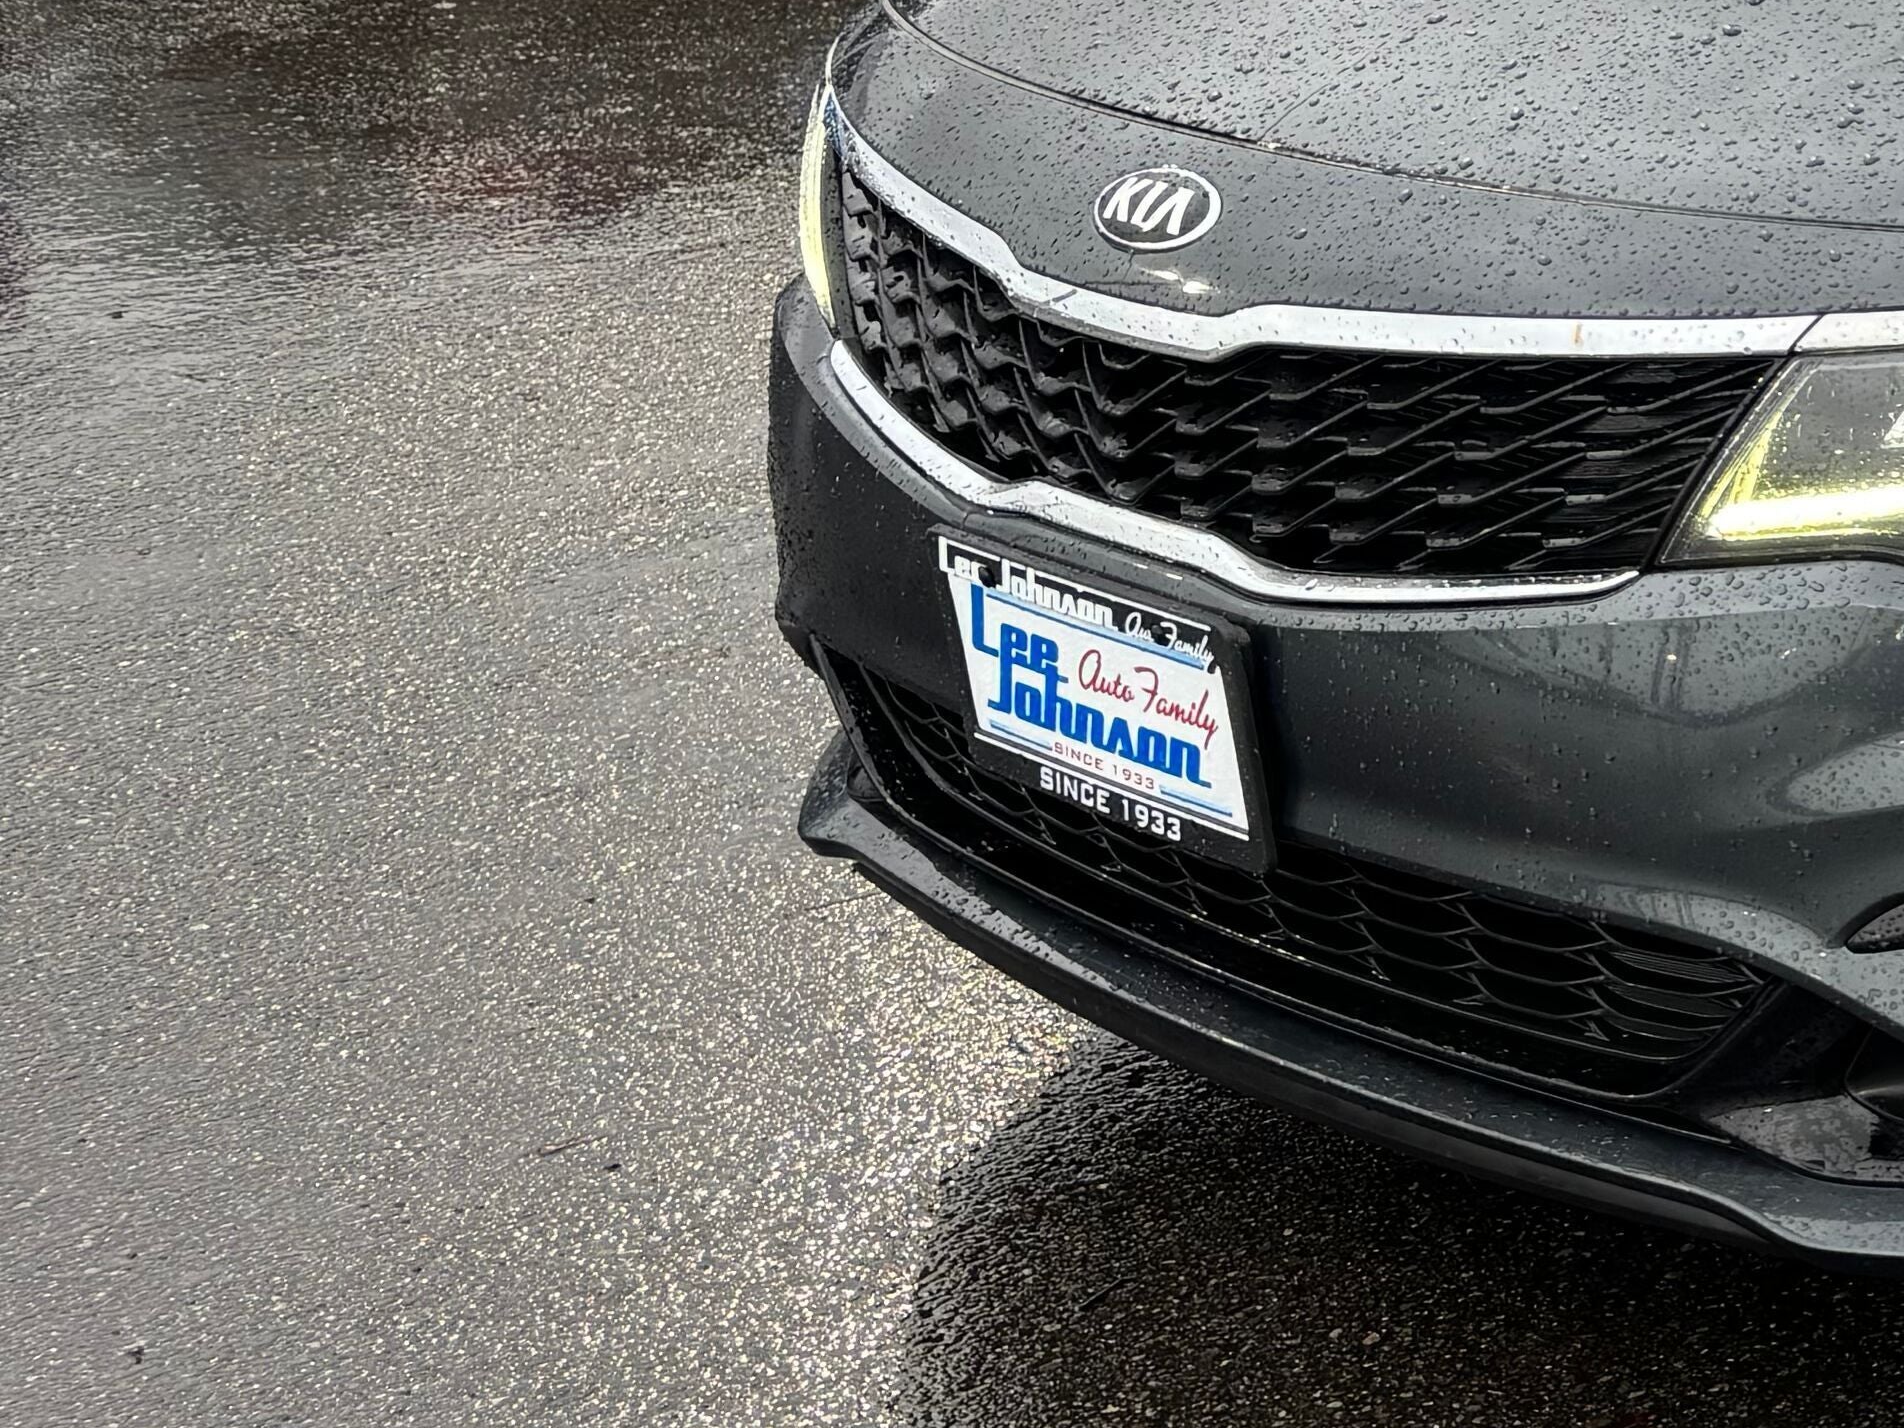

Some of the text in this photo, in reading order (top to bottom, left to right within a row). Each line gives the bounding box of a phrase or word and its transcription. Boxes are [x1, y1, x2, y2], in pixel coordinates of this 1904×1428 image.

[1102, 176, 1195, 236] KIA
[995, 558, 1119, 633] Johnson
[1125, 610, 1158, 643] Au
[1160, 620, 1216, 667] Family
[971, 582, 1219, 750] Lee Auto Family
[987, 662, 1213, 789] Johnson
[1053, 741, 1156, 791] SINCE 1933
[1039, 766, 1182, 843] SINCE 1933
